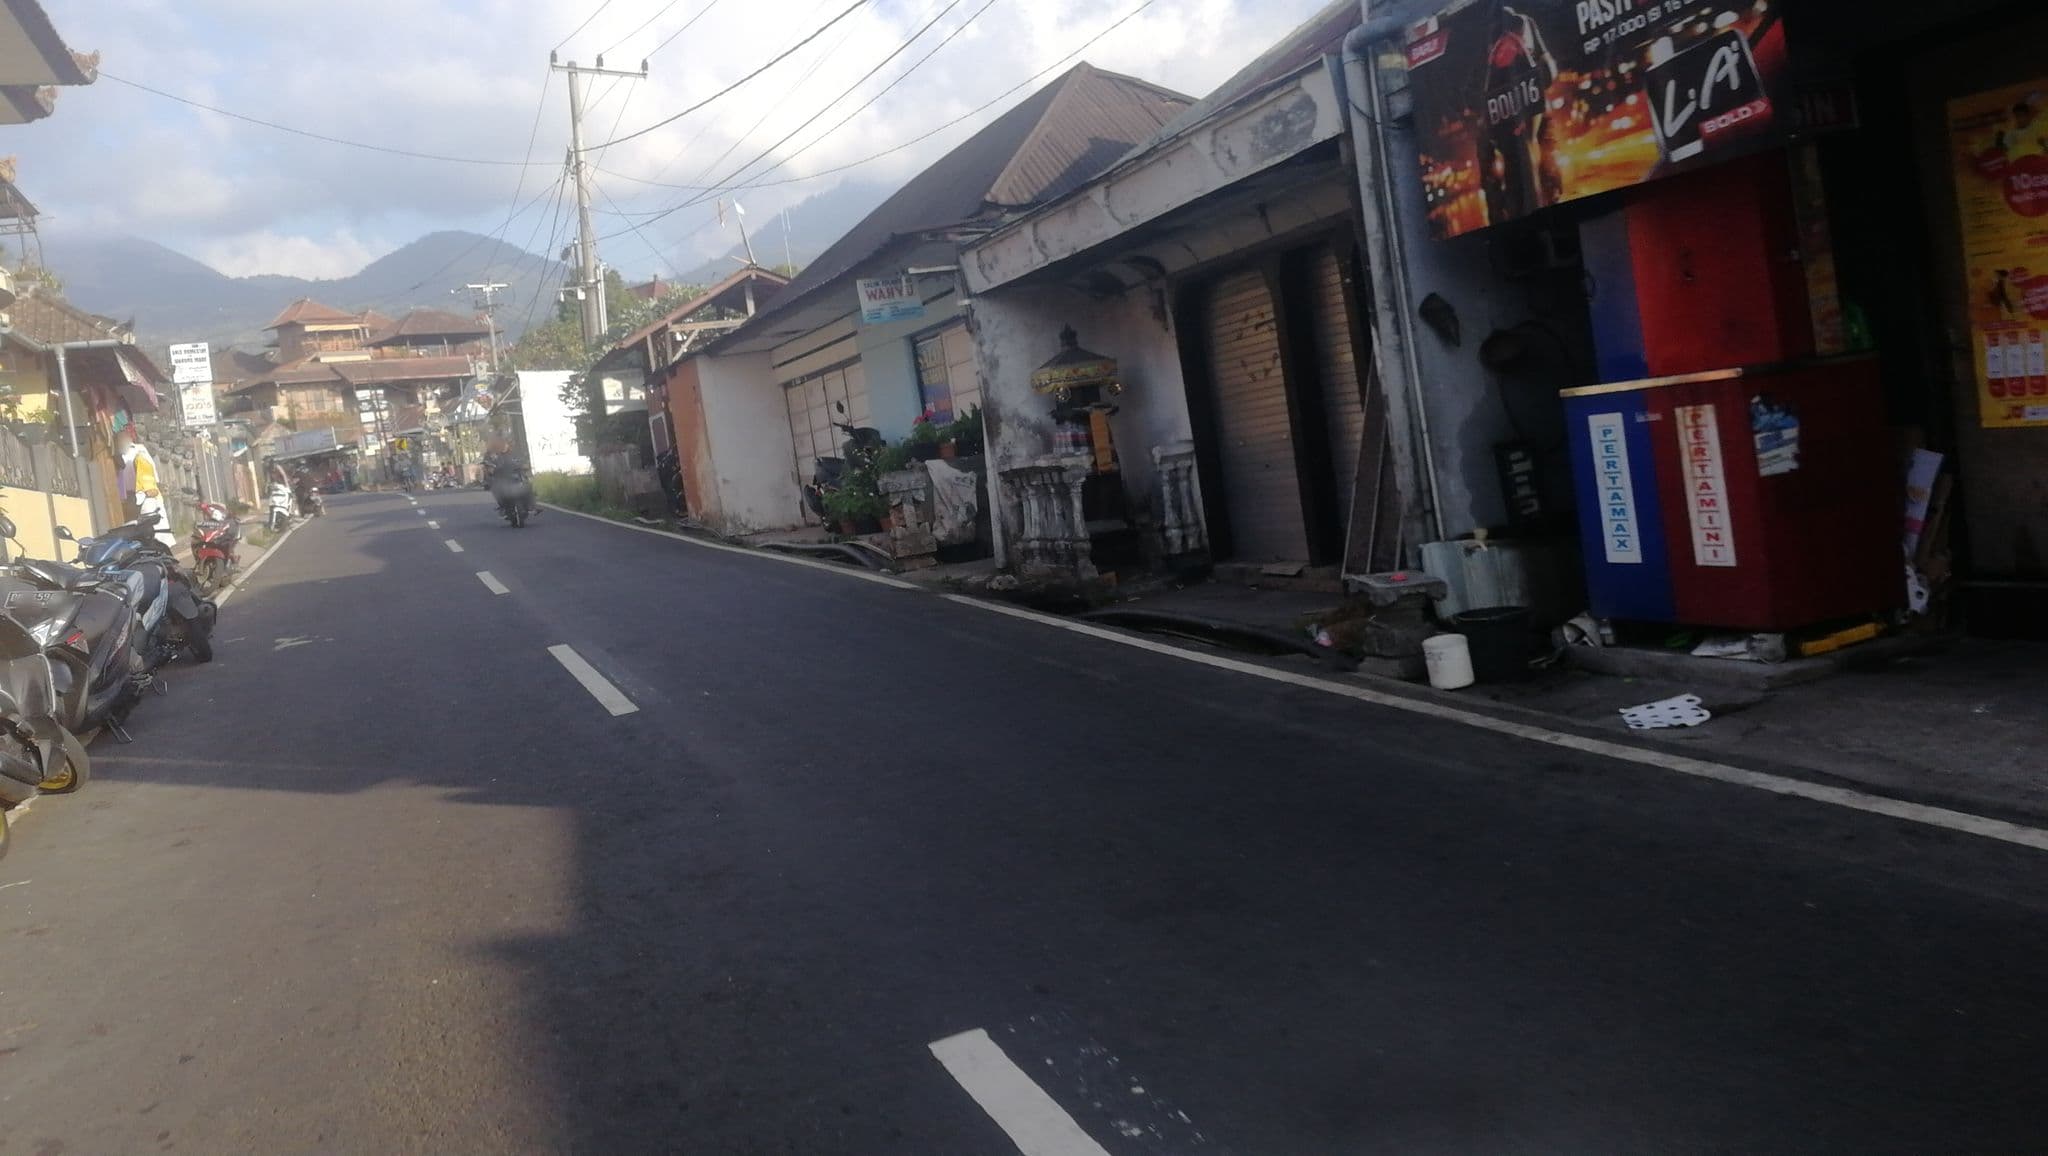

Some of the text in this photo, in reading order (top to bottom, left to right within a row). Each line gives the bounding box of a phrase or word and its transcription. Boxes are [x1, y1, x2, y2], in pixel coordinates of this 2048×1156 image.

[1520, 78, 1540, 106] 16
[1704, 106, 1751, 134] BOLD
[1601, 428, 1629, 549] PERTAMAX
[1689, 408, 1720, 559] PERTAMINI
